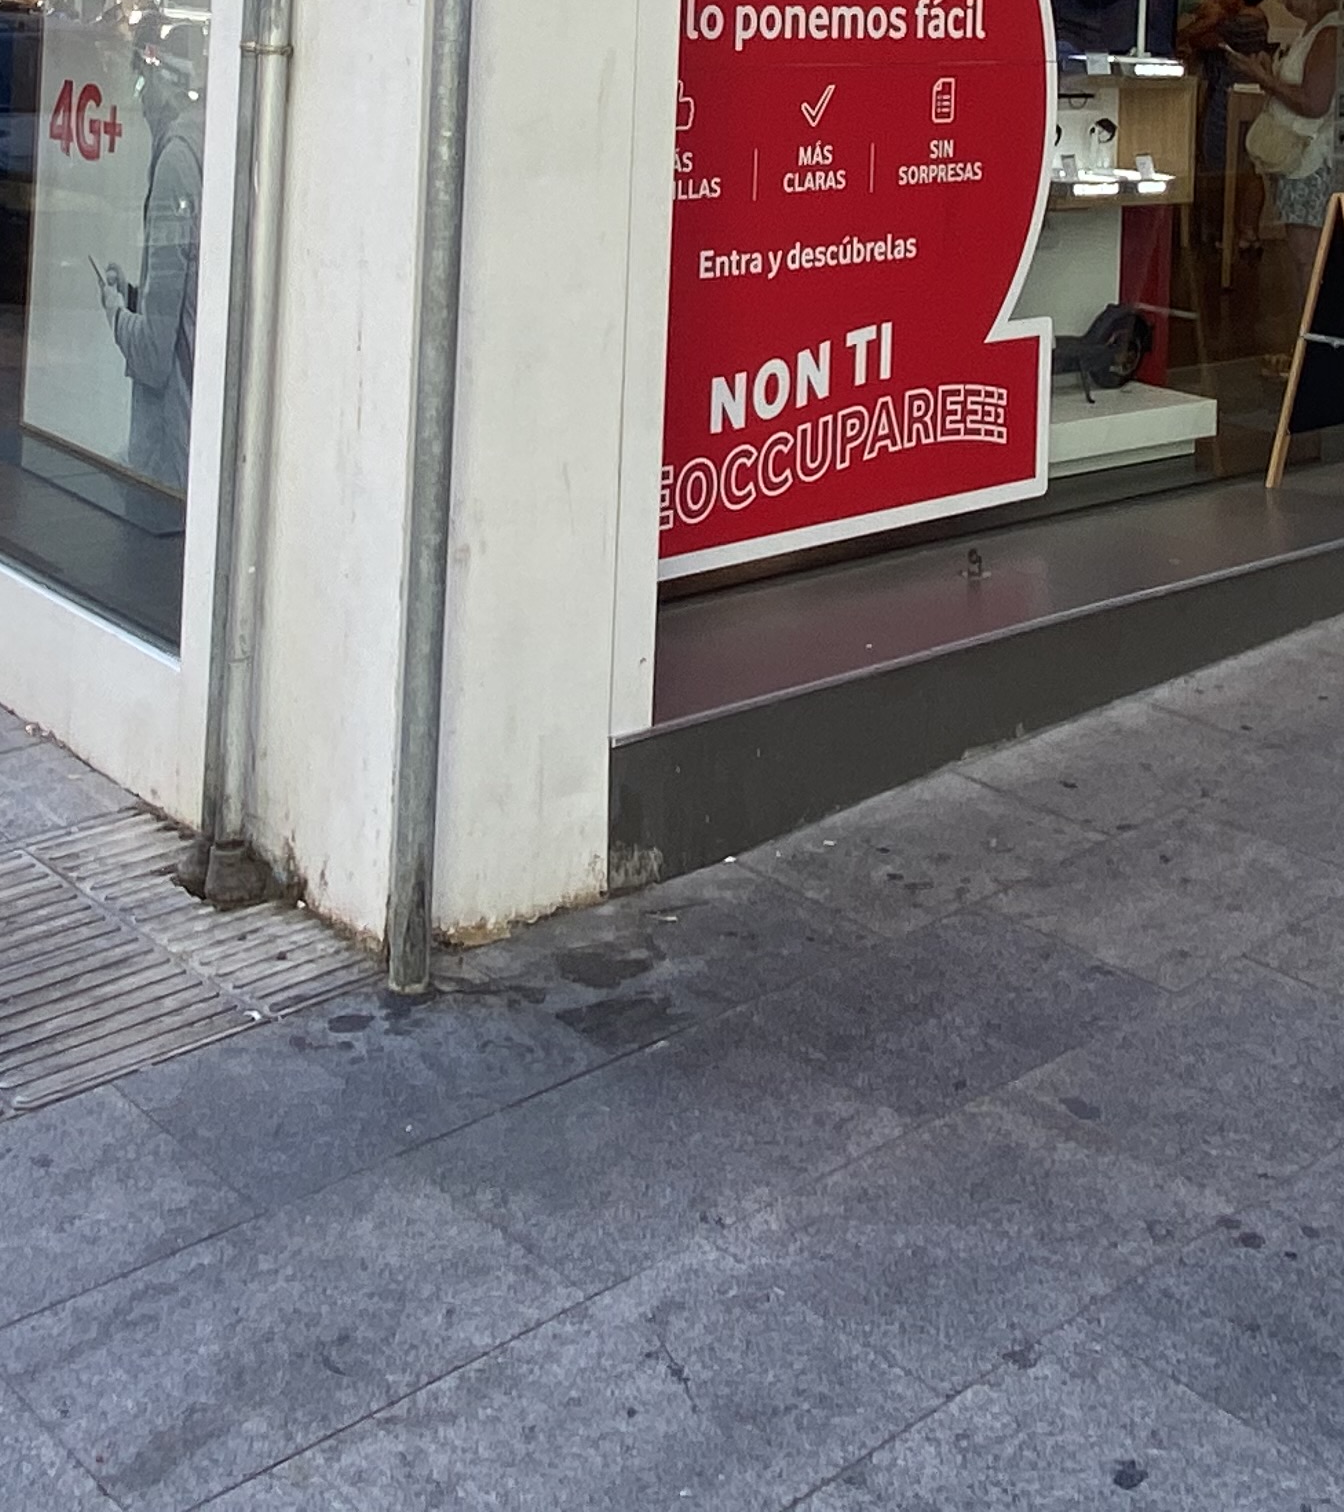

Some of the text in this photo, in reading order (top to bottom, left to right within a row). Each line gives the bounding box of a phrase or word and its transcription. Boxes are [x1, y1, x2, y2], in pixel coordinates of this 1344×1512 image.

[735, 2, 906, 51] ponemos
[49, 79, 122, 161] 4G+
[798, 140, 833, 166] MÁS
[929, 139, 954, 159] SIN
[783, 170, 846, 193] CLARAS
[898, 162, 982, 185] SORPRESAS
[699, 233, 917, 280] Entra y descúbrelas
[710, 321, 894, 434] NON TI
